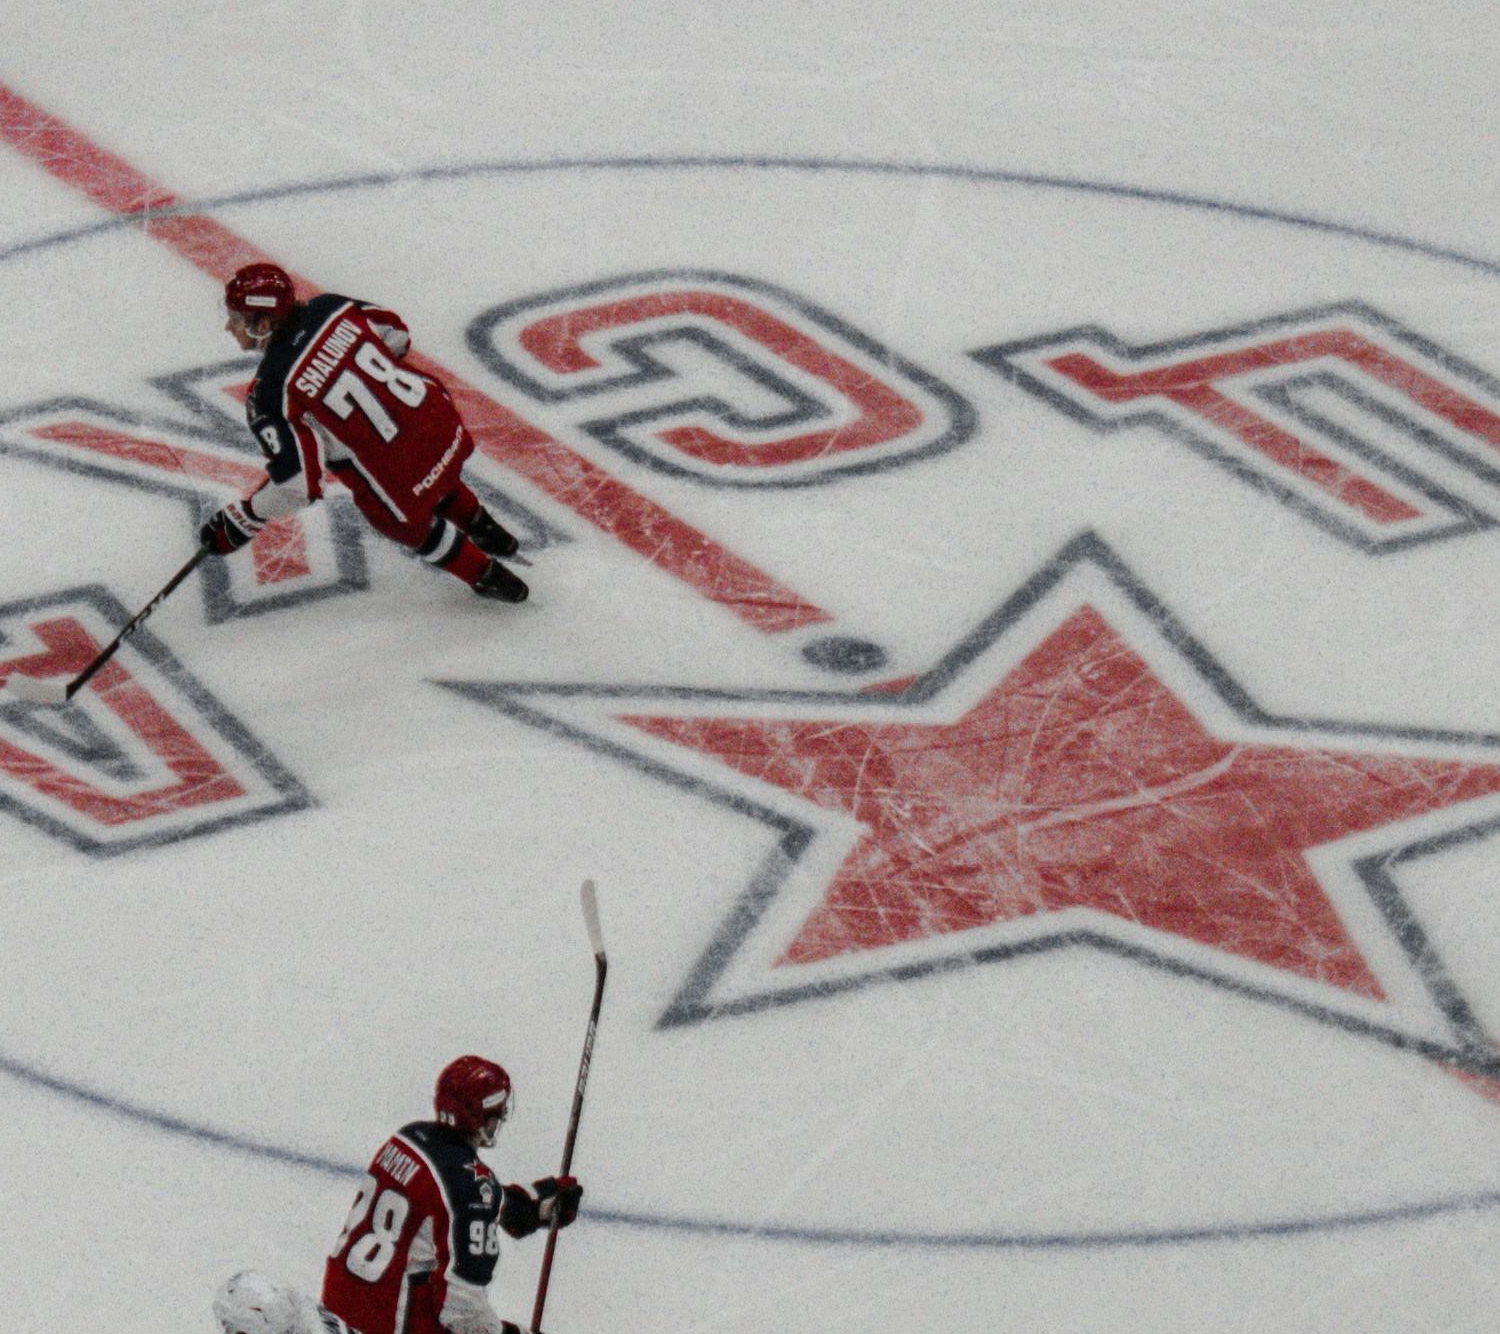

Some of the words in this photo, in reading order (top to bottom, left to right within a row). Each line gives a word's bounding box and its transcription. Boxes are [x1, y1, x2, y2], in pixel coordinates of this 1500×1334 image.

[294, 316, 365, 400] SHALUNOV
[321, 339, 428, 445] 78
[467, 1218, 501, 1257] 98
